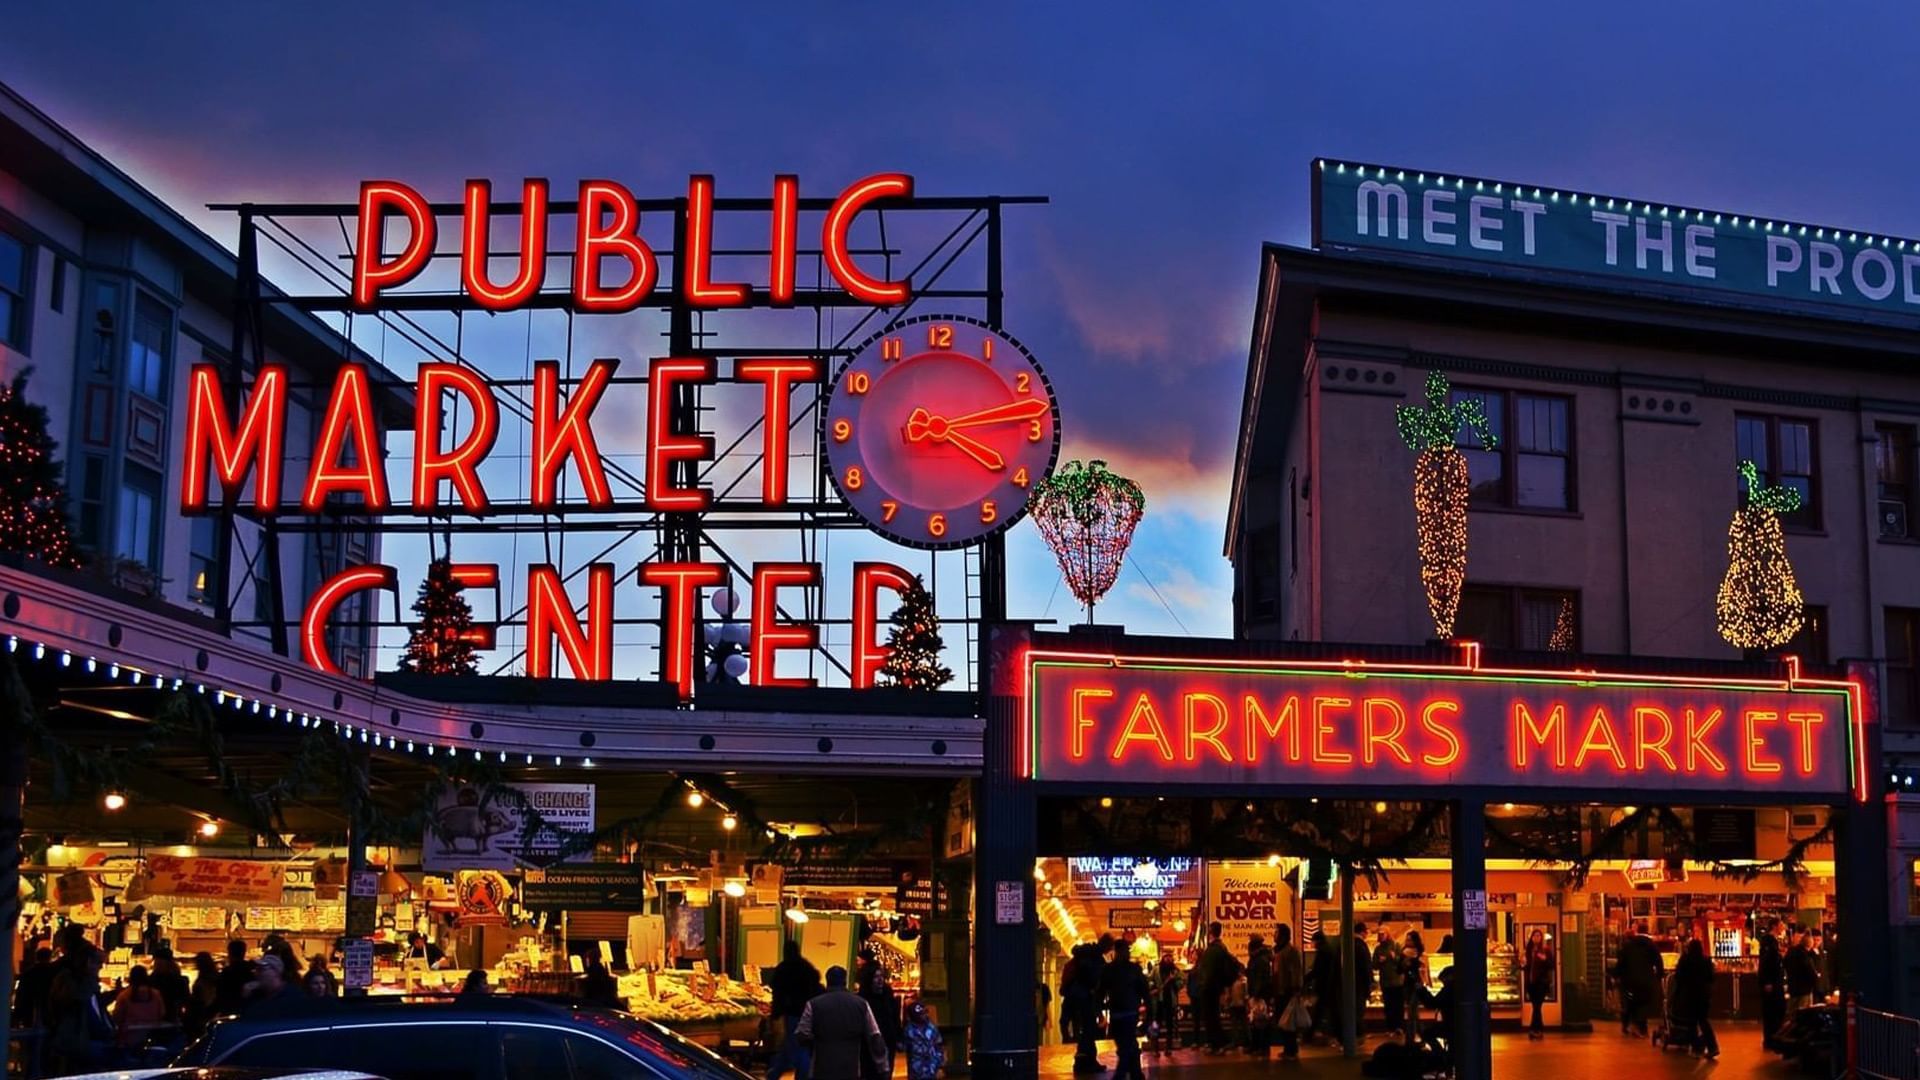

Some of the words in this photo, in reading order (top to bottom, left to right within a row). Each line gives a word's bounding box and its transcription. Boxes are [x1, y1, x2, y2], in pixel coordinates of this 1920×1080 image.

[1355, 180, 1547, 256] MEET
[1591, 210, 1718, 279] THE
[352, 174, 915, 312] PUBLIC
[928, 327, 953, 348] 12
[883, 340, 902, 361] 11
[984, 340, 993, 360] 1
[847, 374, 870, 394] 10
[1016, 373, 1031, 393] 2
[181, 356, 823, 518] MARKET
[834, 421, 850, 441] 9
[1027, 422, 1042, 442] 3
[846, 468, 862, 489] 8
[1012, 468, 1029, 488] 4
[882, 502, 897, 522] 7
[980, 502, 996, 522] 5
[929, 514, 945, 537] 6
[1071, 687, 1460, 768] FARMERS
[1512, 700, 1824, 774] MARKET
[534, 791, 592, 809] CHANGE
[605, 876, 639, 884] SEAFOOD
[1092, 874, 1178, 889] VIEWPOINT
[1223, 878, 1276, 889] Welcome
[1220, 890, 1277, 910] DOWN
[1215, 905, 1277, 920] UNDER
